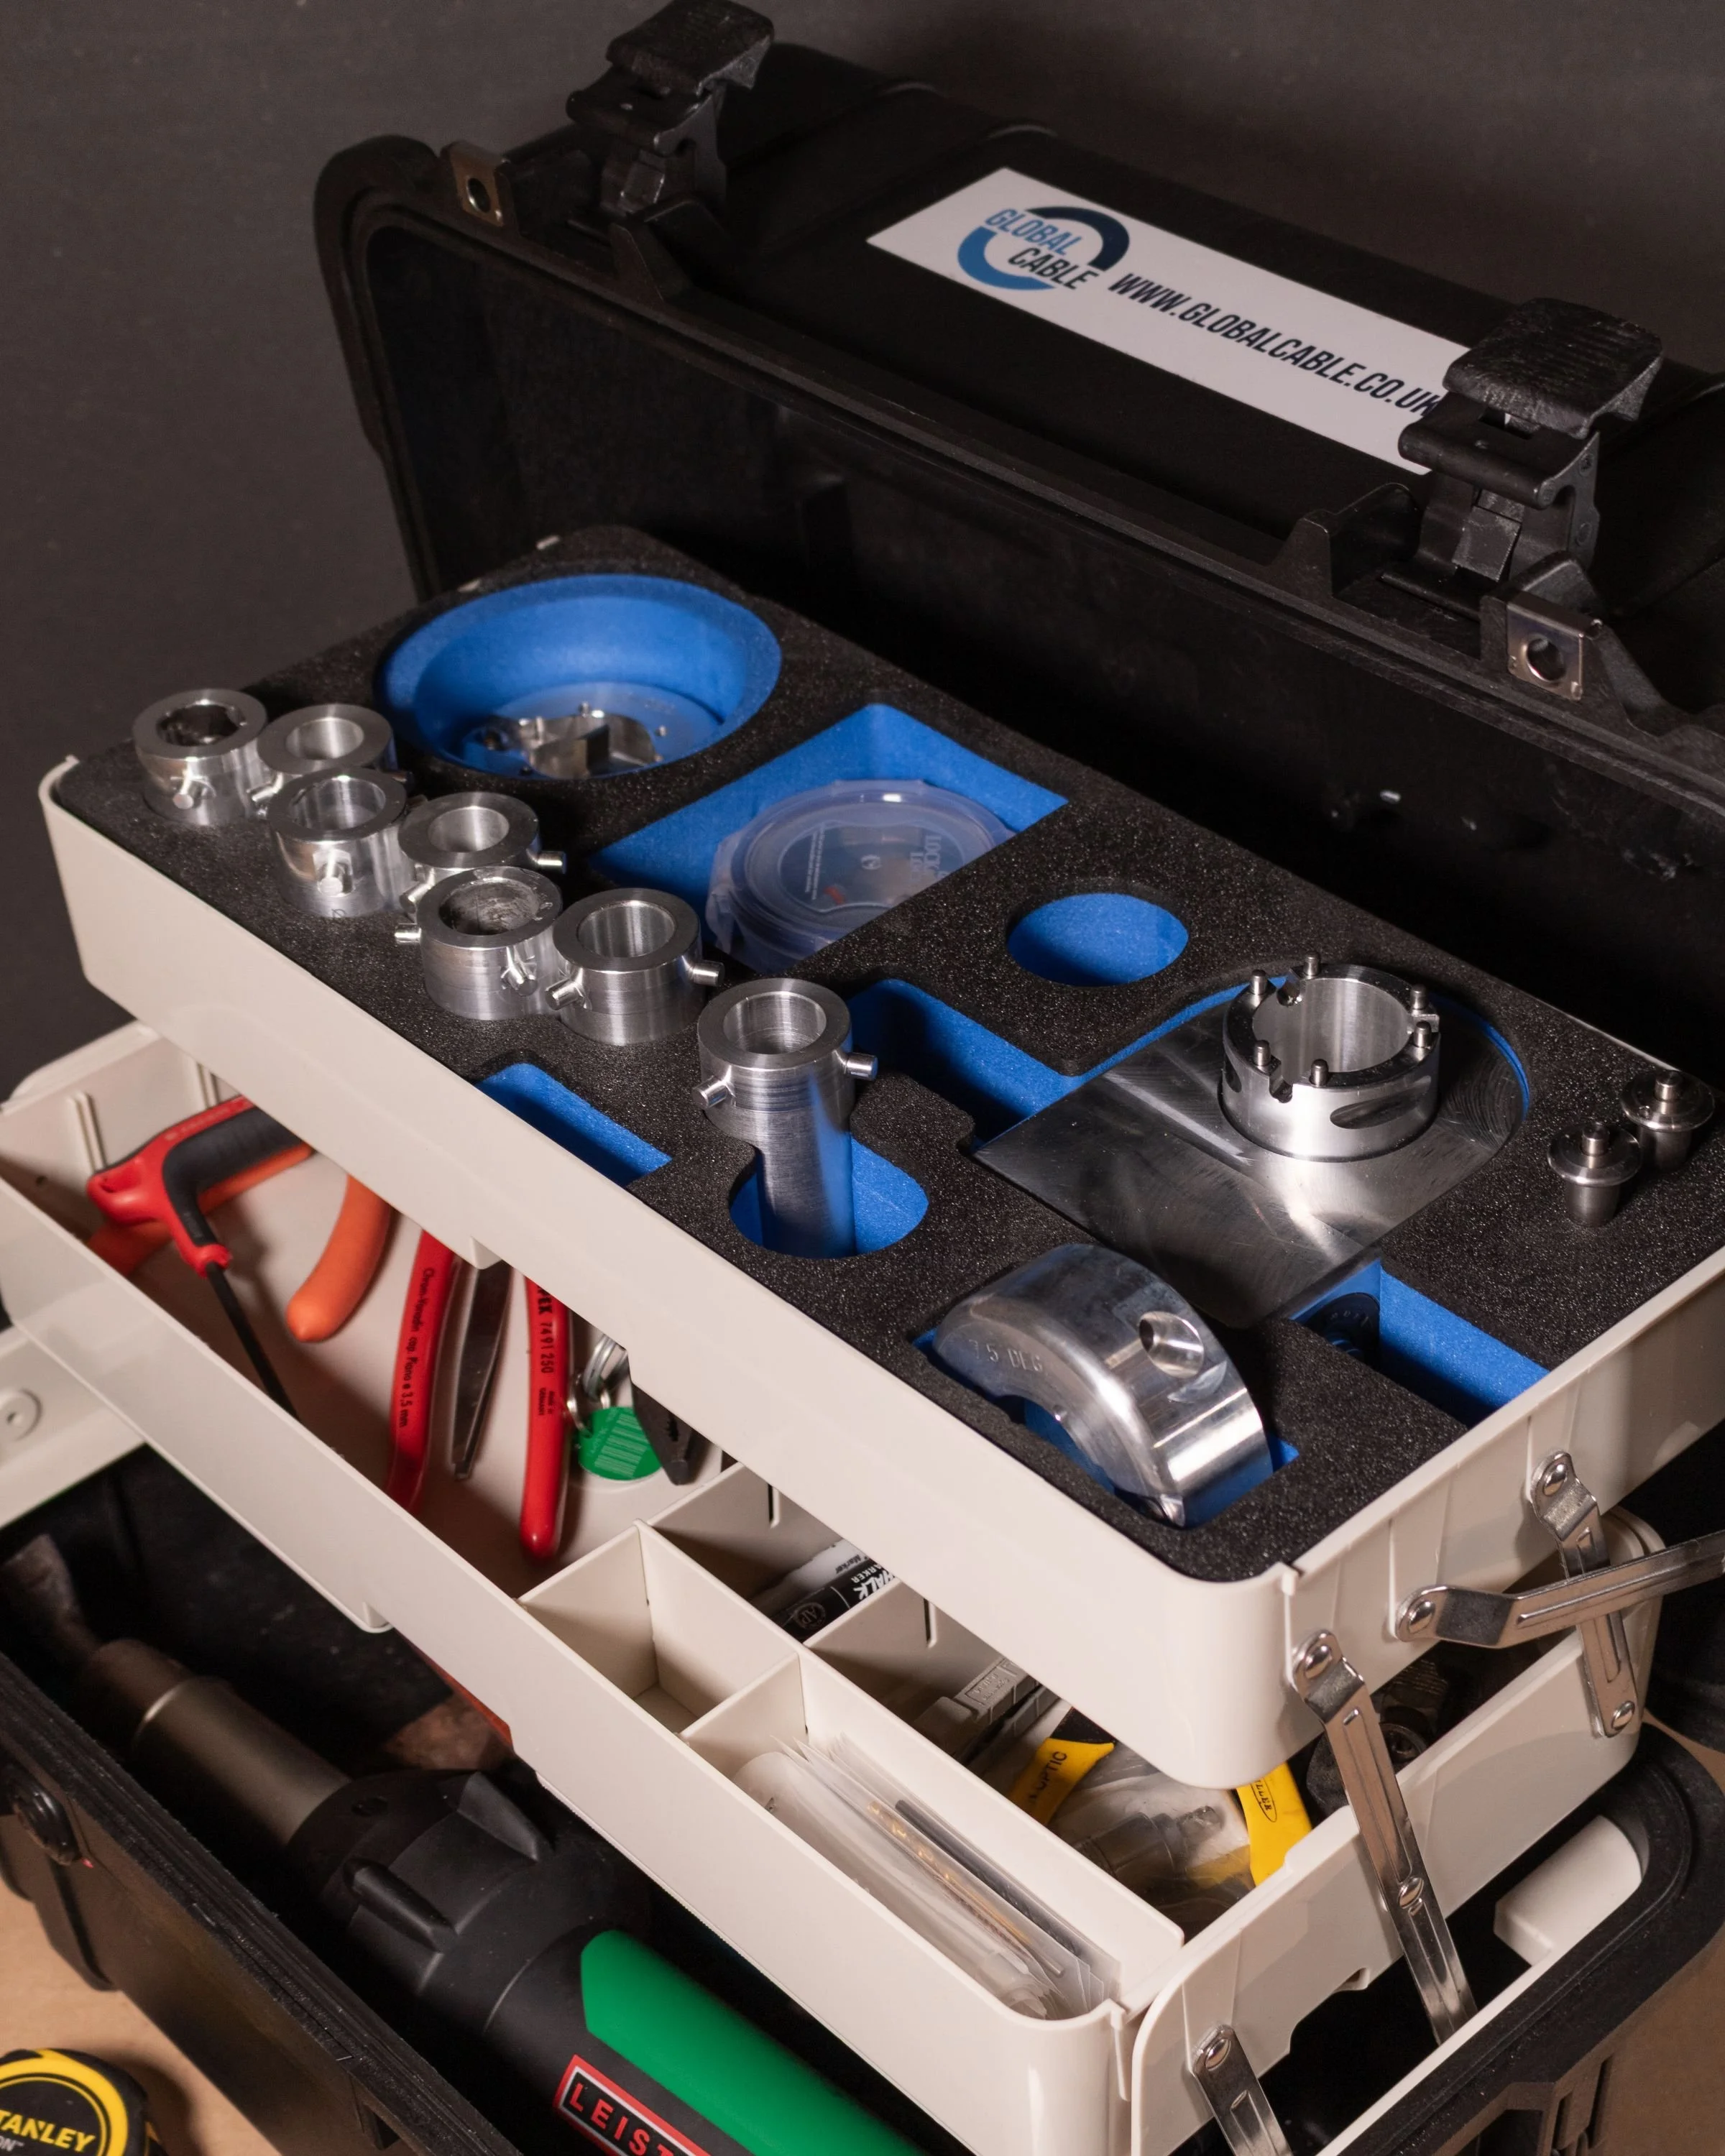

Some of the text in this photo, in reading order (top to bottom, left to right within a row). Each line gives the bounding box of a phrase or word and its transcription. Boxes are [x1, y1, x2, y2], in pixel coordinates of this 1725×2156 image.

[985, 209, 1082, 256] GLOBAL
[1008, 248, 1100, 290] CABLE
[1108, 272, 1440, 417] WWW.GLOBALCABLE.CO.UK
[836, 1554, 861, 1574] Marker
[850, 1564, 883, 1583] ARKER
[853, 1570, 896, 1600] HALK
[0, 2109, 96, 2153] TANLEY
